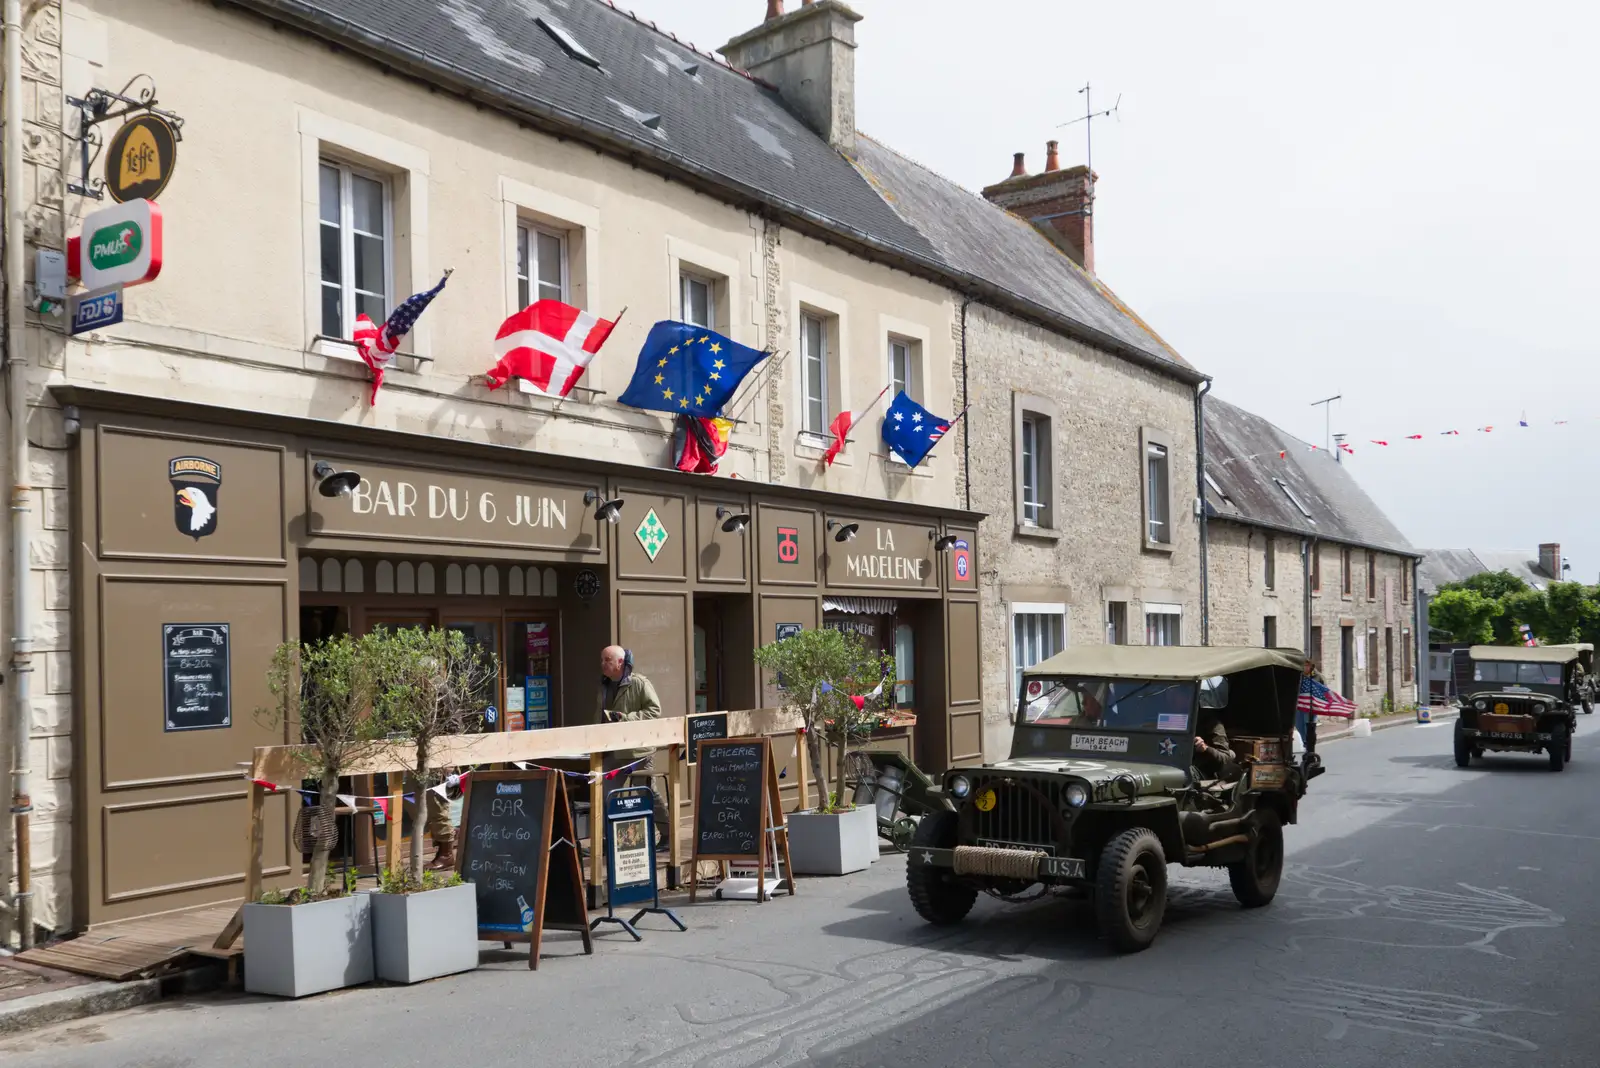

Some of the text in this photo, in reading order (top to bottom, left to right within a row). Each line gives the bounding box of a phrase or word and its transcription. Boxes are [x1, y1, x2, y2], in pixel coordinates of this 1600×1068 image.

[93, 240, 120, 259] PMU
[79, 301, 102, 323] FDJ
[175, 460, 217, 475] AIRBORNE
[352, 478, 567, 530] BAR DU 6 JUIN
[876, 527, 895, 551] LA
[846, 554, 924, 580] MADELEINE
[1075, 736, 1125, 746] UTAH BEACH
[491, 798, 526, 817] BAR
[717, 811, 743, 823] BAR
